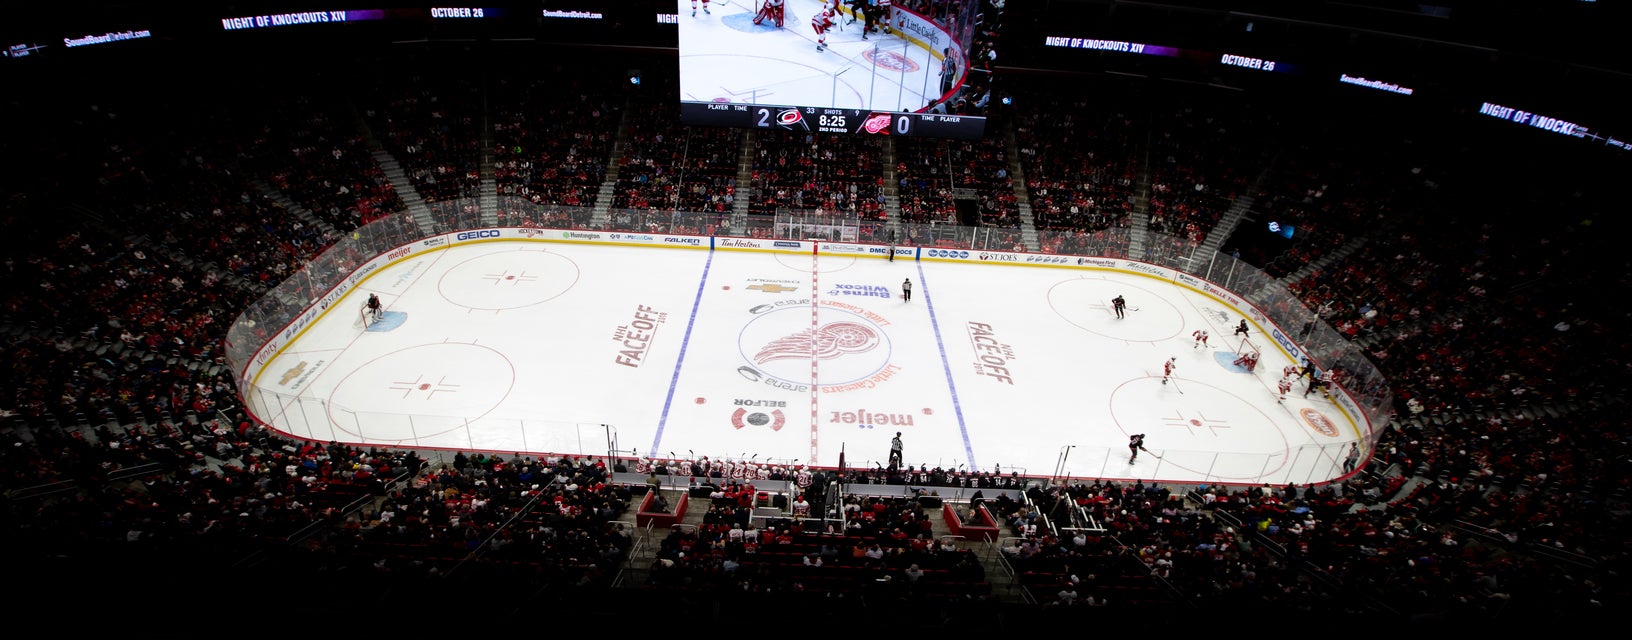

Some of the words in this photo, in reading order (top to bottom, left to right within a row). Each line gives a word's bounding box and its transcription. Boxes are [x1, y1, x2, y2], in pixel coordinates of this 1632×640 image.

[222, 16, 254, 30] NIGHT
[256, 16, 270, 28] OF
[271, 12, 328, 26] KNOCKOUTS
[330, 10, 346, 22] XIV
[431, 8, 471, 18] OCTOBER
[473, 8, 484, 18] 26
[1046, 36, 1070, 48] NIGHT
[1071, 38, 1082, 48] OF
[1083, 39, 1128, 52] KNOCKOUTS
[1130, 42, 1144, 54] XIV
[1221, 54, 1262, 69] OCTOBER
[1262, 60, 1275, 72] 26
[758, 108, 770, 127] 2
[819, 115, 846, 127] 8:25
[1480, 102, 1515, 120] NIGHT
[1514, 110, 1530, 124] OF
[897, 116, 910, 134] 0
[457, 230, 500, 241] GEICO
[570, 232, 600, 240] Huntington
[721, 238, 733, 248] Tim
[734, 239, 760, 248] Hortons
[388, 247, 411, 260] meijer
[836, 284, 888, 292] Wilcox
[842, 290, 890, 298] Burns
[864, 310, 892, 327] Little
[612, 324, 628, 342] NHL
[1272, 328, 1299, 358] GEICO
[874, 363, 902, 383] Little
[764, 377, 808, 393] arena
[822, 378, 876, 394] Caesars
[734, 398, 786, 408] BELFOR
[830, 408, 914, 430] meijer
